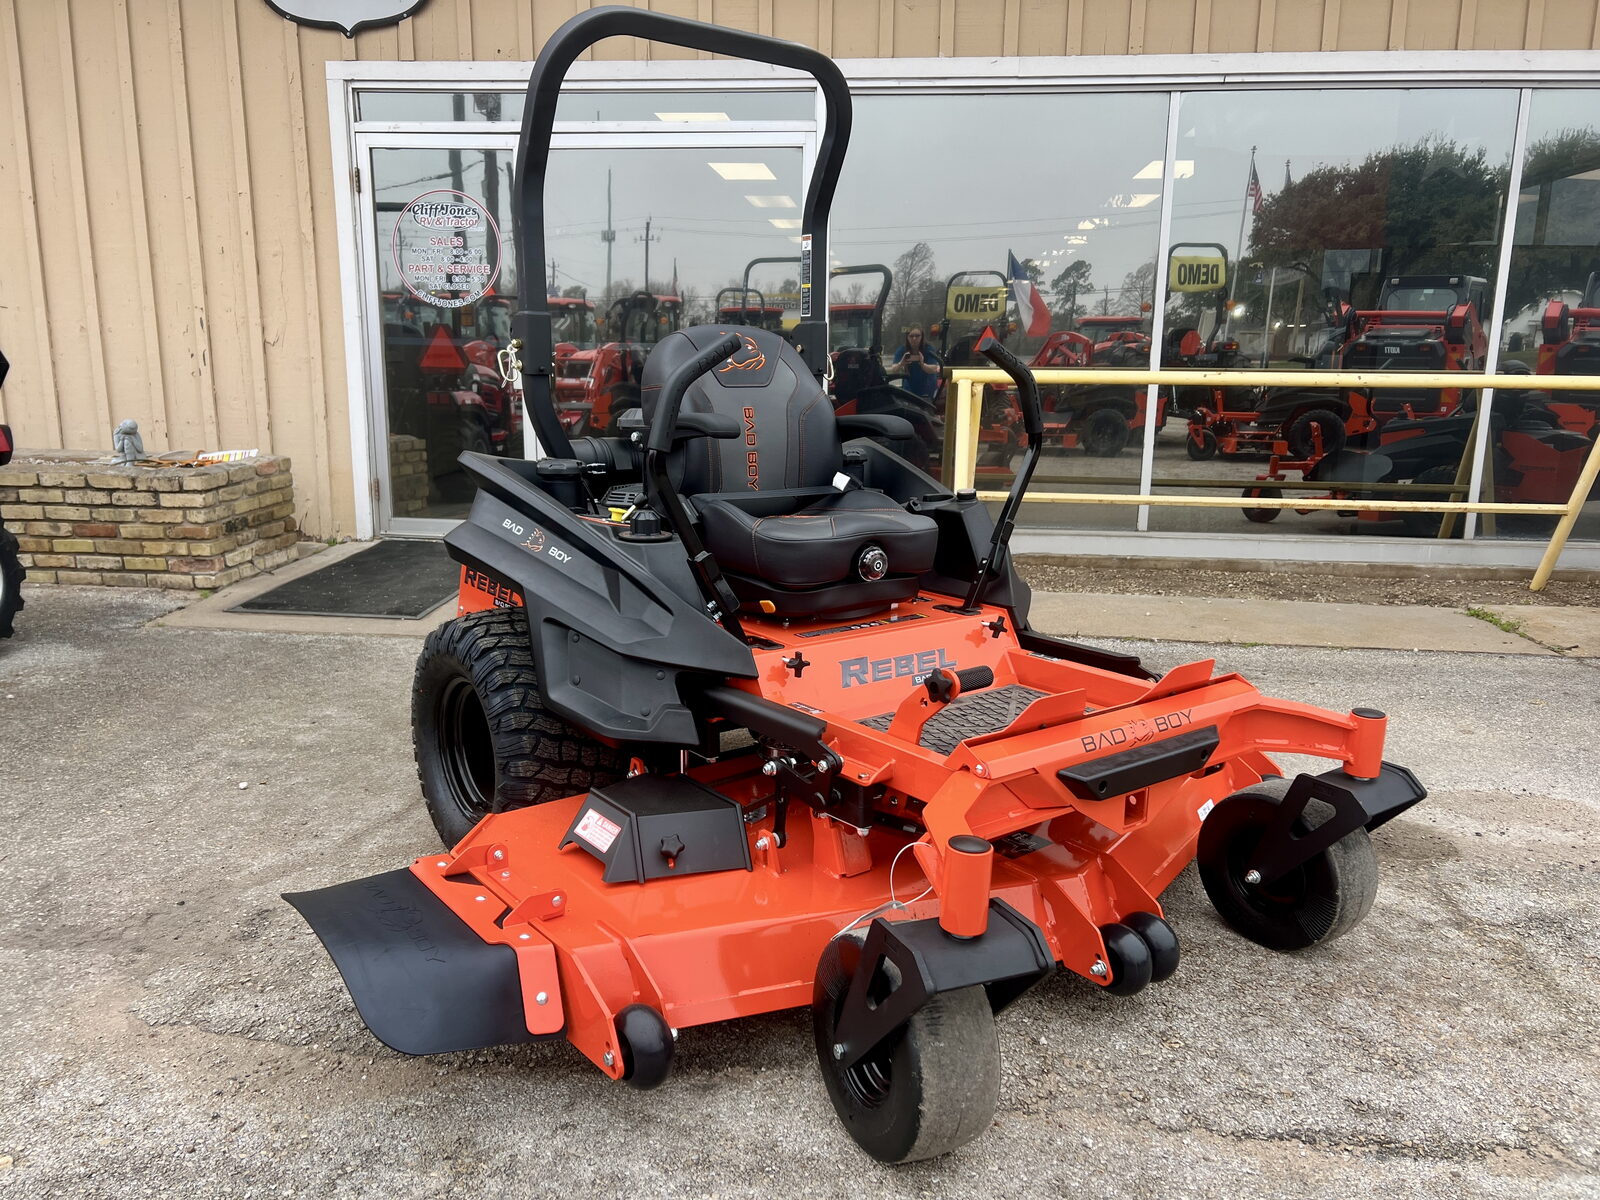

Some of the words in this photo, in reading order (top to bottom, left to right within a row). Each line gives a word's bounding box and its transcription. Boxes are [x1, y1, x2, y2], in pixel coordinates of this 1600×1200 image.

[412, 203, 440, 217] Cliff
[441, 204, 478, 216] Jones
[420, 217, 433, 226] RV
[434, 217, 443, 226] &
[446, 217, 478, 226] Tractor
[430, 237, 463, 246] SALES
[408, 264, 434, 273] PART
[437, 264, 444, 273] &
[447, 264, 490, 274] SERVICE
[417, 290, 481, 307] CLIFFJONES.COM
[743, 406, 756, 446] BAD
[746, 451, 760, 491] BOY
[502, 518, 524, 536] BAD
[548, 546, 573, 565] BOY
[464, 566, 519, 606] REBEL
[1080, 727, 1127, 753] BAD
[1154, 708, 1193, 733] BOY
